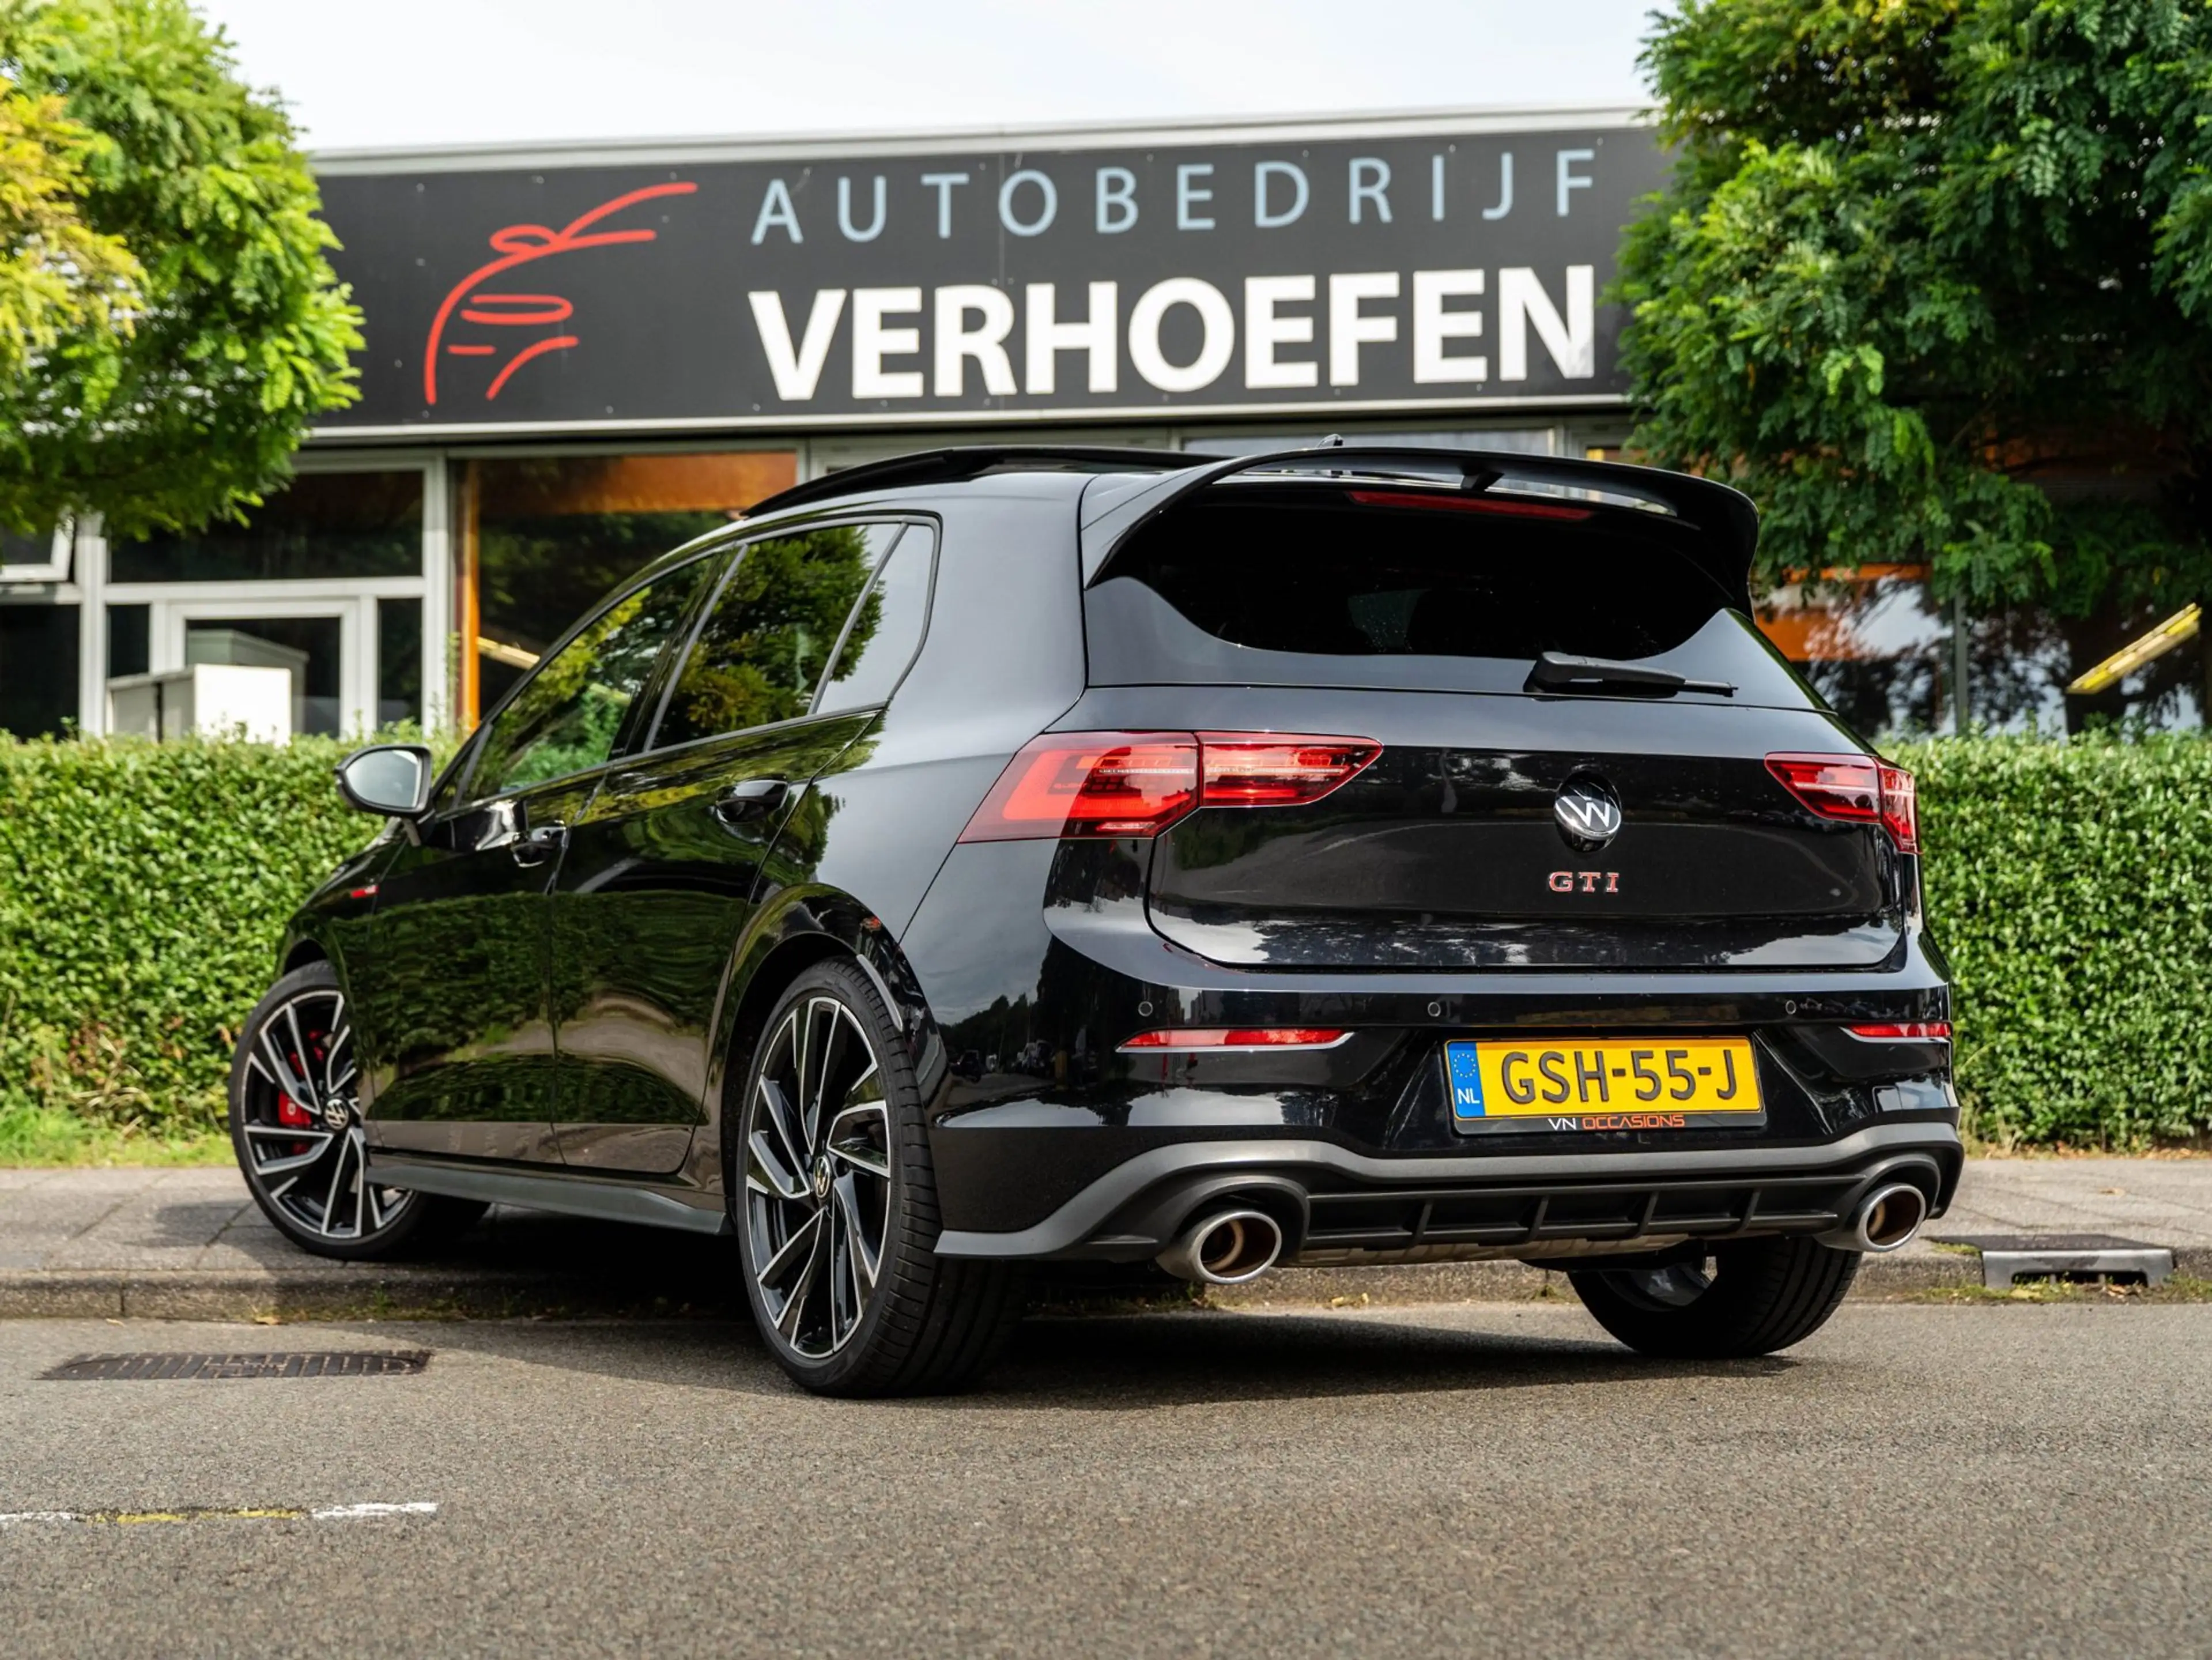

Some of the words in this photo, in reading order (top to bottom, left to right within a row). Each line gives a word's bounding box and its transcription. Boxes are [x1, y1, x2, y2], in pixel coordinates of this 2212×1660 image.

[751, 148, 1595, 246] AUTOBEDRIJF
[748, 265, 1596, 402] VERHOEFEN
[1548, 871, 1619, 893] GTI
[1501, 1049, 1737, 1104] GSH-55-J
[1457, 1088, 1480, 1104] NL
[1547, 1117, 1577, 1130] VN
[1581, 1114, 1685, 1130] OCCASIONS
